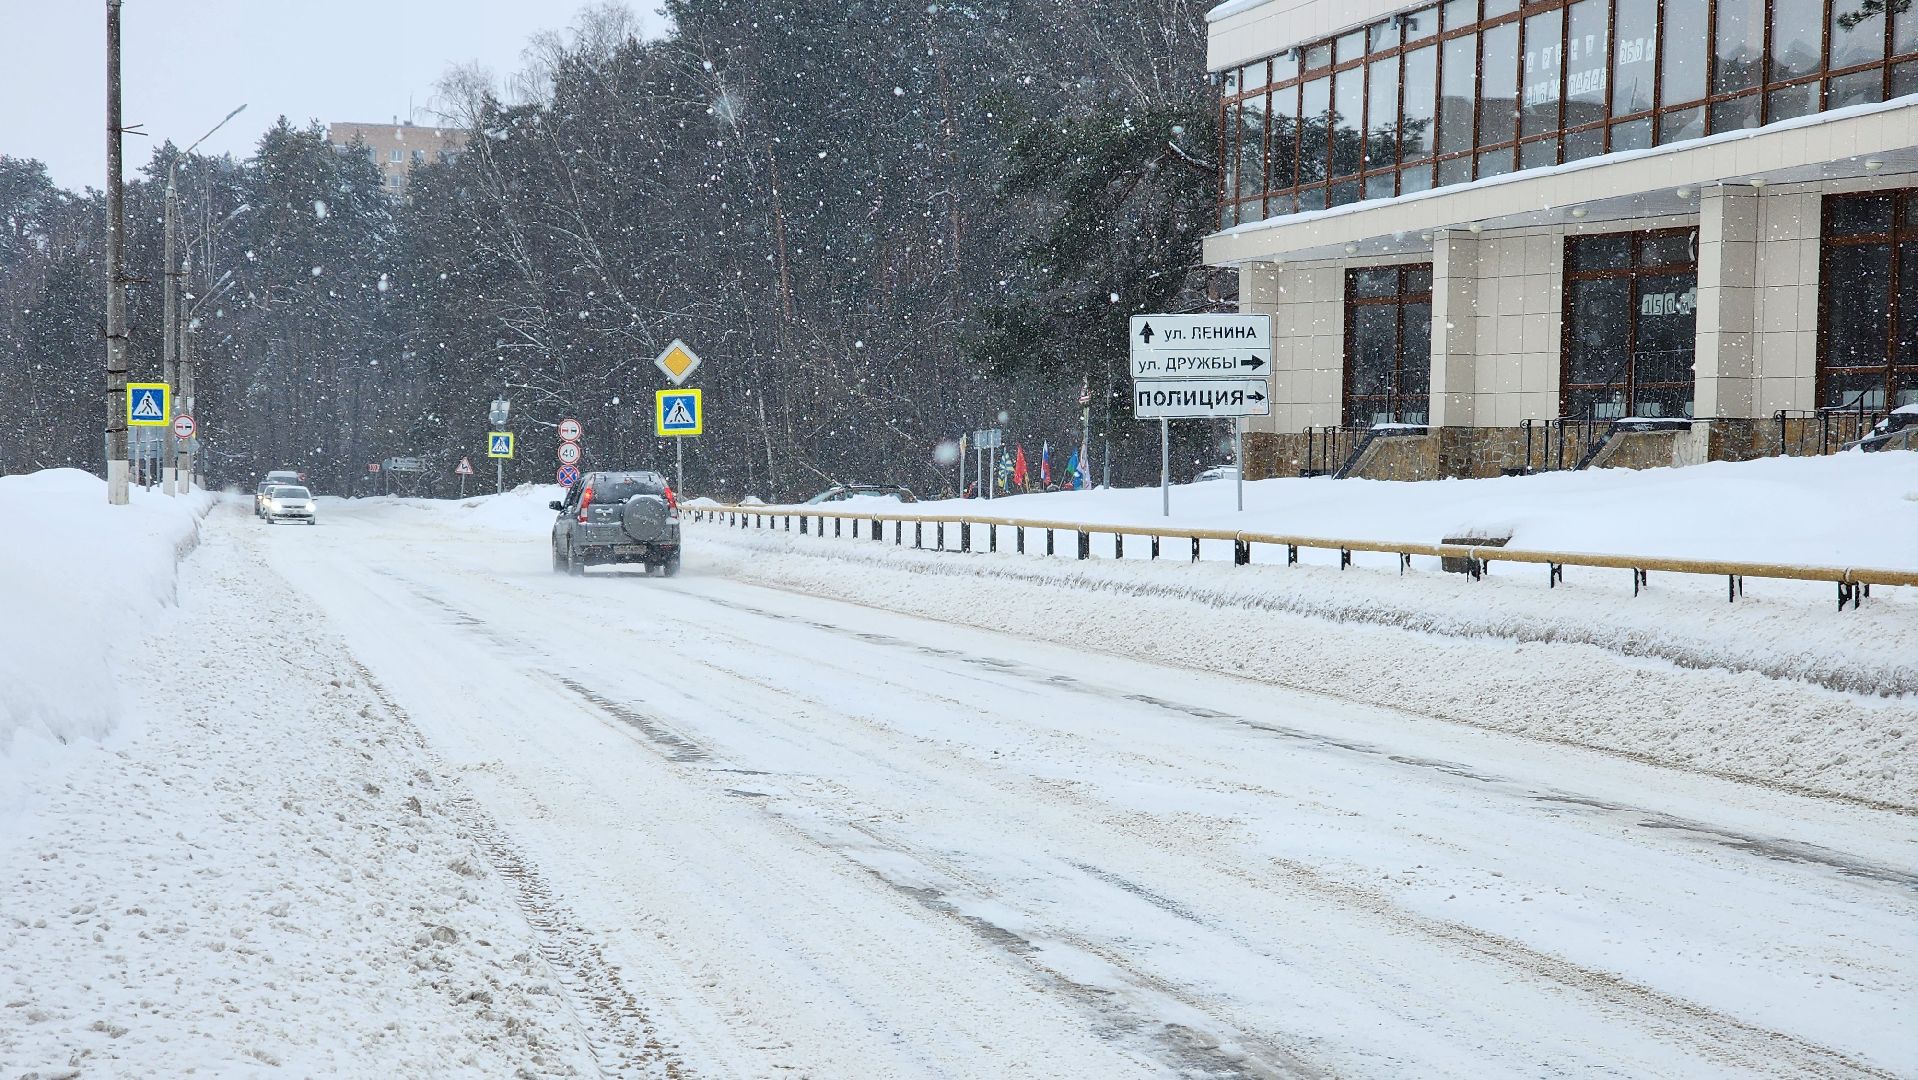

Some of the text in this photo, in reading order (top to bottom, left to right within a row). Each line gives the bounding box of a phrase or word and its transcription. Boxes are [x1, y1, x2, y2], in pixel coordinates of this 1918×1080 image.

[1643, 298, 1675, 314] 150
[1164, 326, 1257, 342] ул. ЛЕНИНА
[1138, 357, 1237, 373] ул. ДРУЖБЫ
[1138, 390, 1244, 409] ПОЛИЦИЯ
[562, 448, 575, 458] 40
